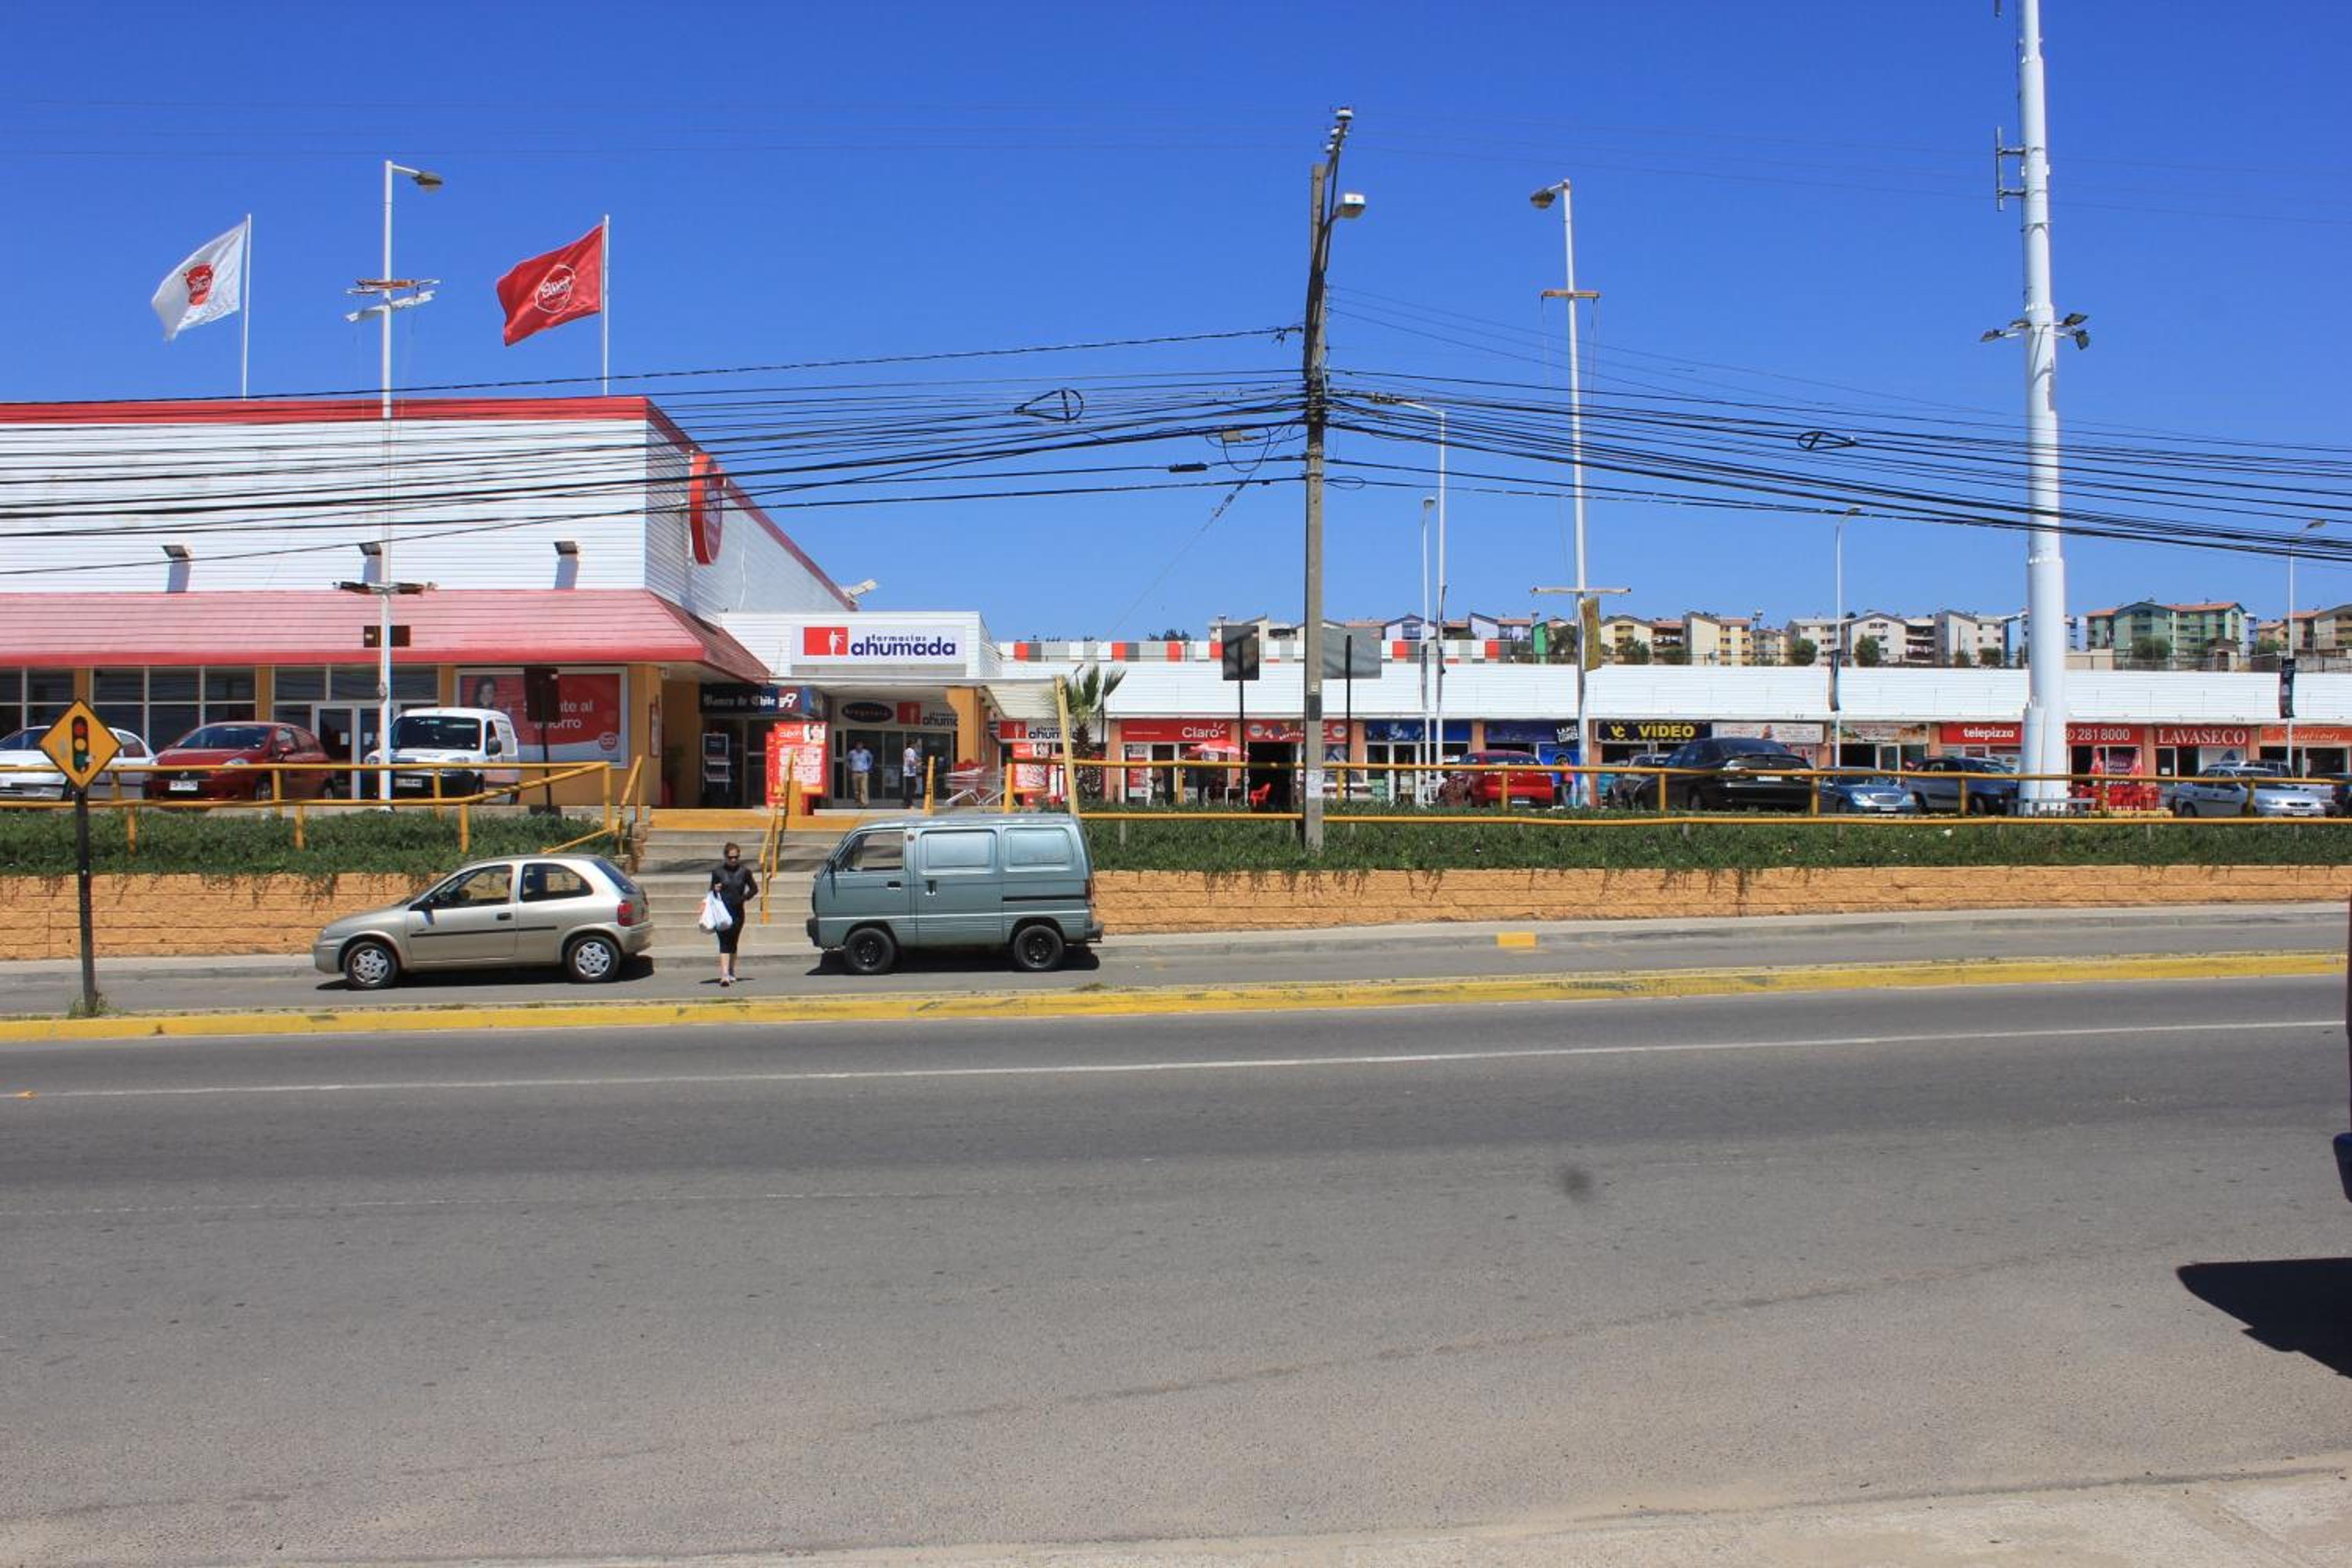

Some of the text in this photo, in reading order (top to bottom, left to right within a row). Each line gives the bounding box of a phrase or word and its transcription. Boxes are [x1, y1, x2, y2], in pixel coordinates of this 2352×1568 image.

[871, 633, 927, 642] farmacias
[851, 636, 956, 656] ahumada
[580, 699, 593, 713] al
[1181, 726, 1219, 739] Claro
[1638, 724, 1696, 738] VIDEO
[1963, 727, 2014, 741] telepizza
[2077, 728, 2130, 741] 281 8000
[2158, 728, 2246, 745] LAVASECO
